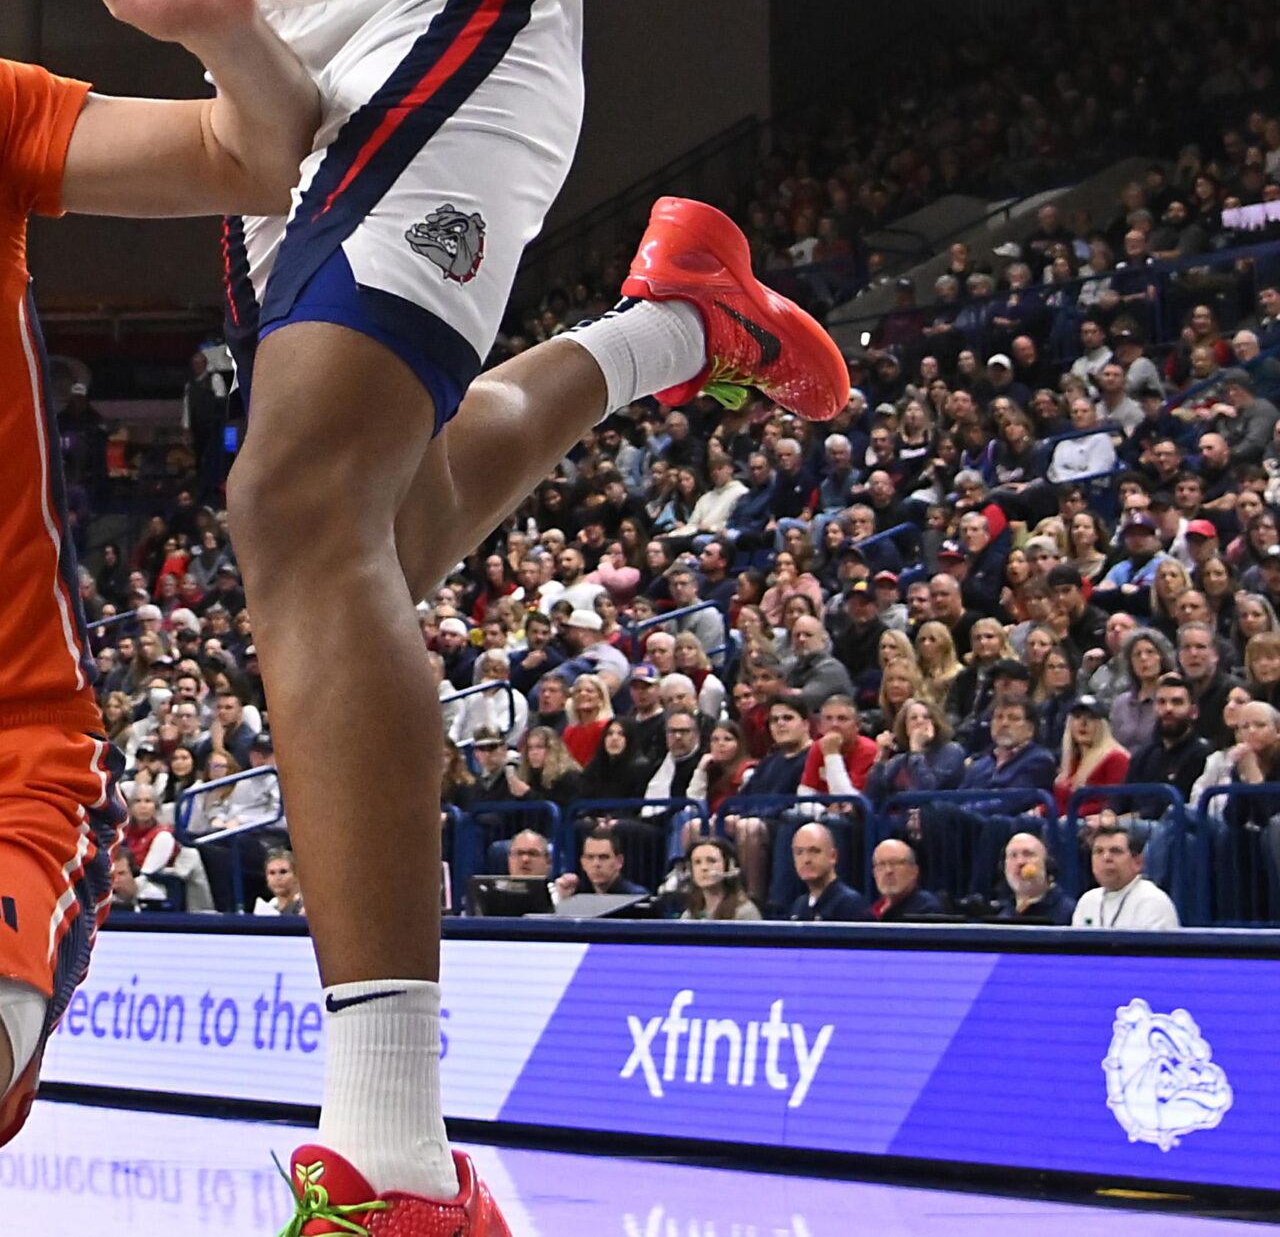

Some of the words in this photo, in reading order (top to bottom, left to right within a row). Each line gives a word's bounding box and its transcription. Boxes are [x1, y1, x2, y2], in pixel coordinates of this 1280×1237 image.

[200, 991, 238, 1047] to
[254, 973, 321, 1054] the
[620, 990, 834, 1109] xfinity
